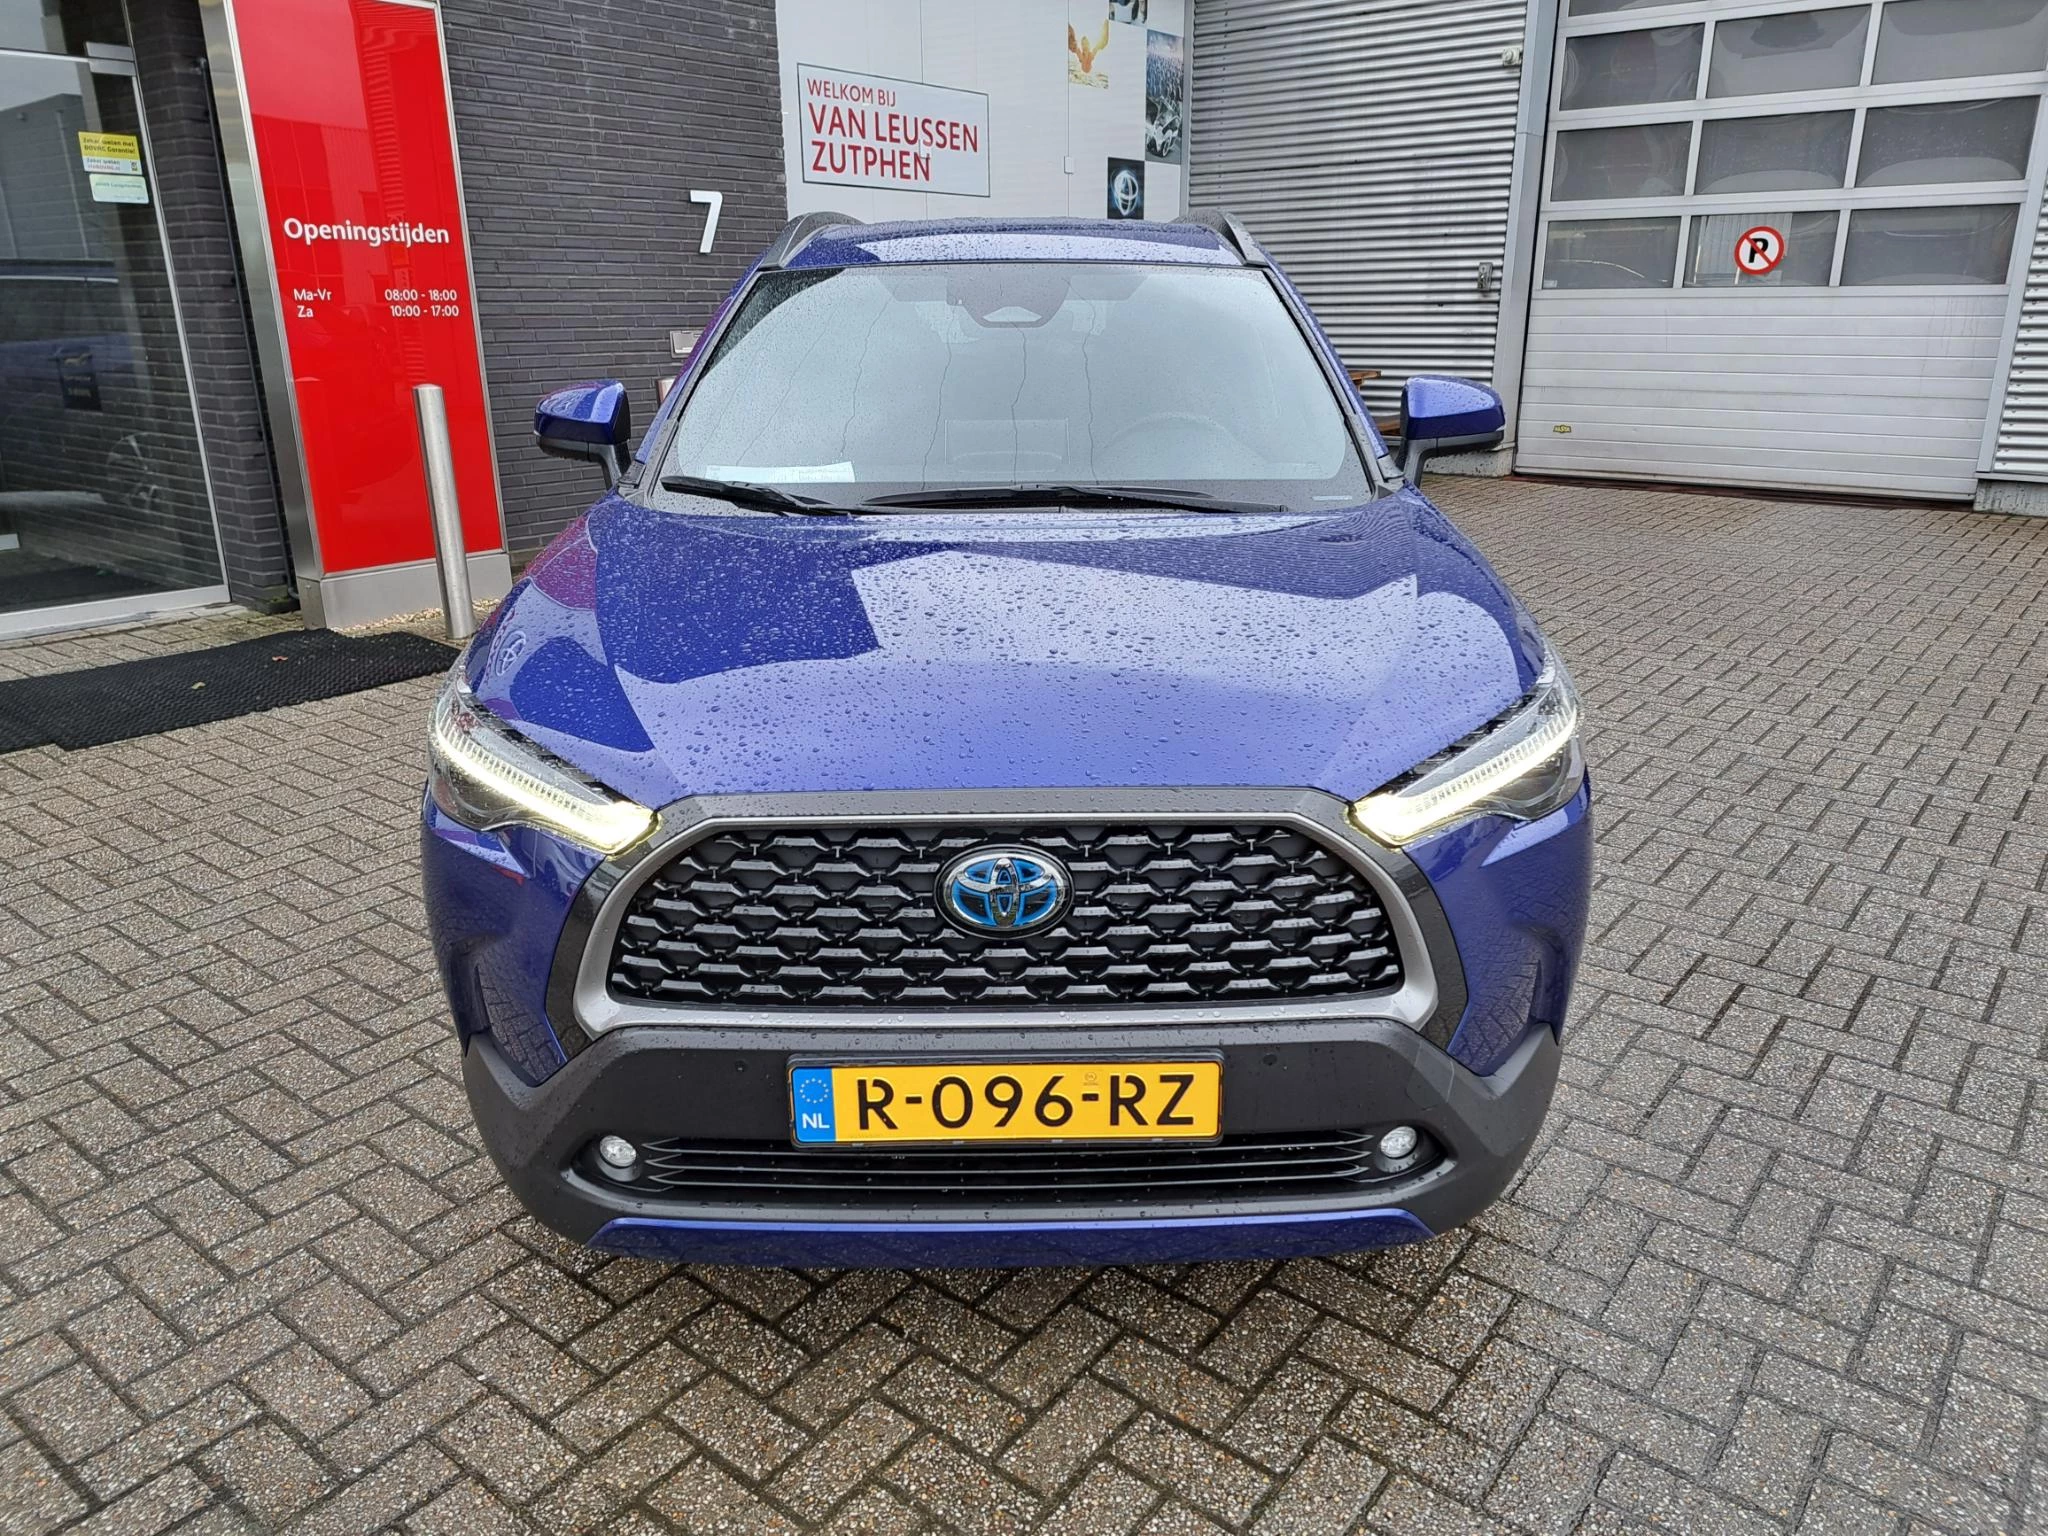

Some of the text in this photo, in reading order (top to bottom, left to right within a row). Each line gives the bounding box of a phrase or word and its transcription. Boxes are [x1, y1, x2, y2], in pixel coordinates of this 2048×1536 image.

[807, 77, 896, 107] WELKOM BIJ
[808, 102, 978, 153] VAN LEUSSEN
[811, 140, 930, 182] ZUTPHEN
[284, 217, 450, 248] Openingstijden
[690, 189, 723, 253] 7
[1748, 237, 1769, 263] P
[293, 288, 332, 301] Ma-Vr
[384, 289, 418, 301] 08:00
[429, 289, 457, 301] 18:00
[297, 305, 313, 318] Za
[390, 305, 420, 317] 10:00
[431, 305, 459, 317] 17:00
[857, 1074, 1195, 1130] R-096-RZ
[802, 1112, 829, 1129] NL
